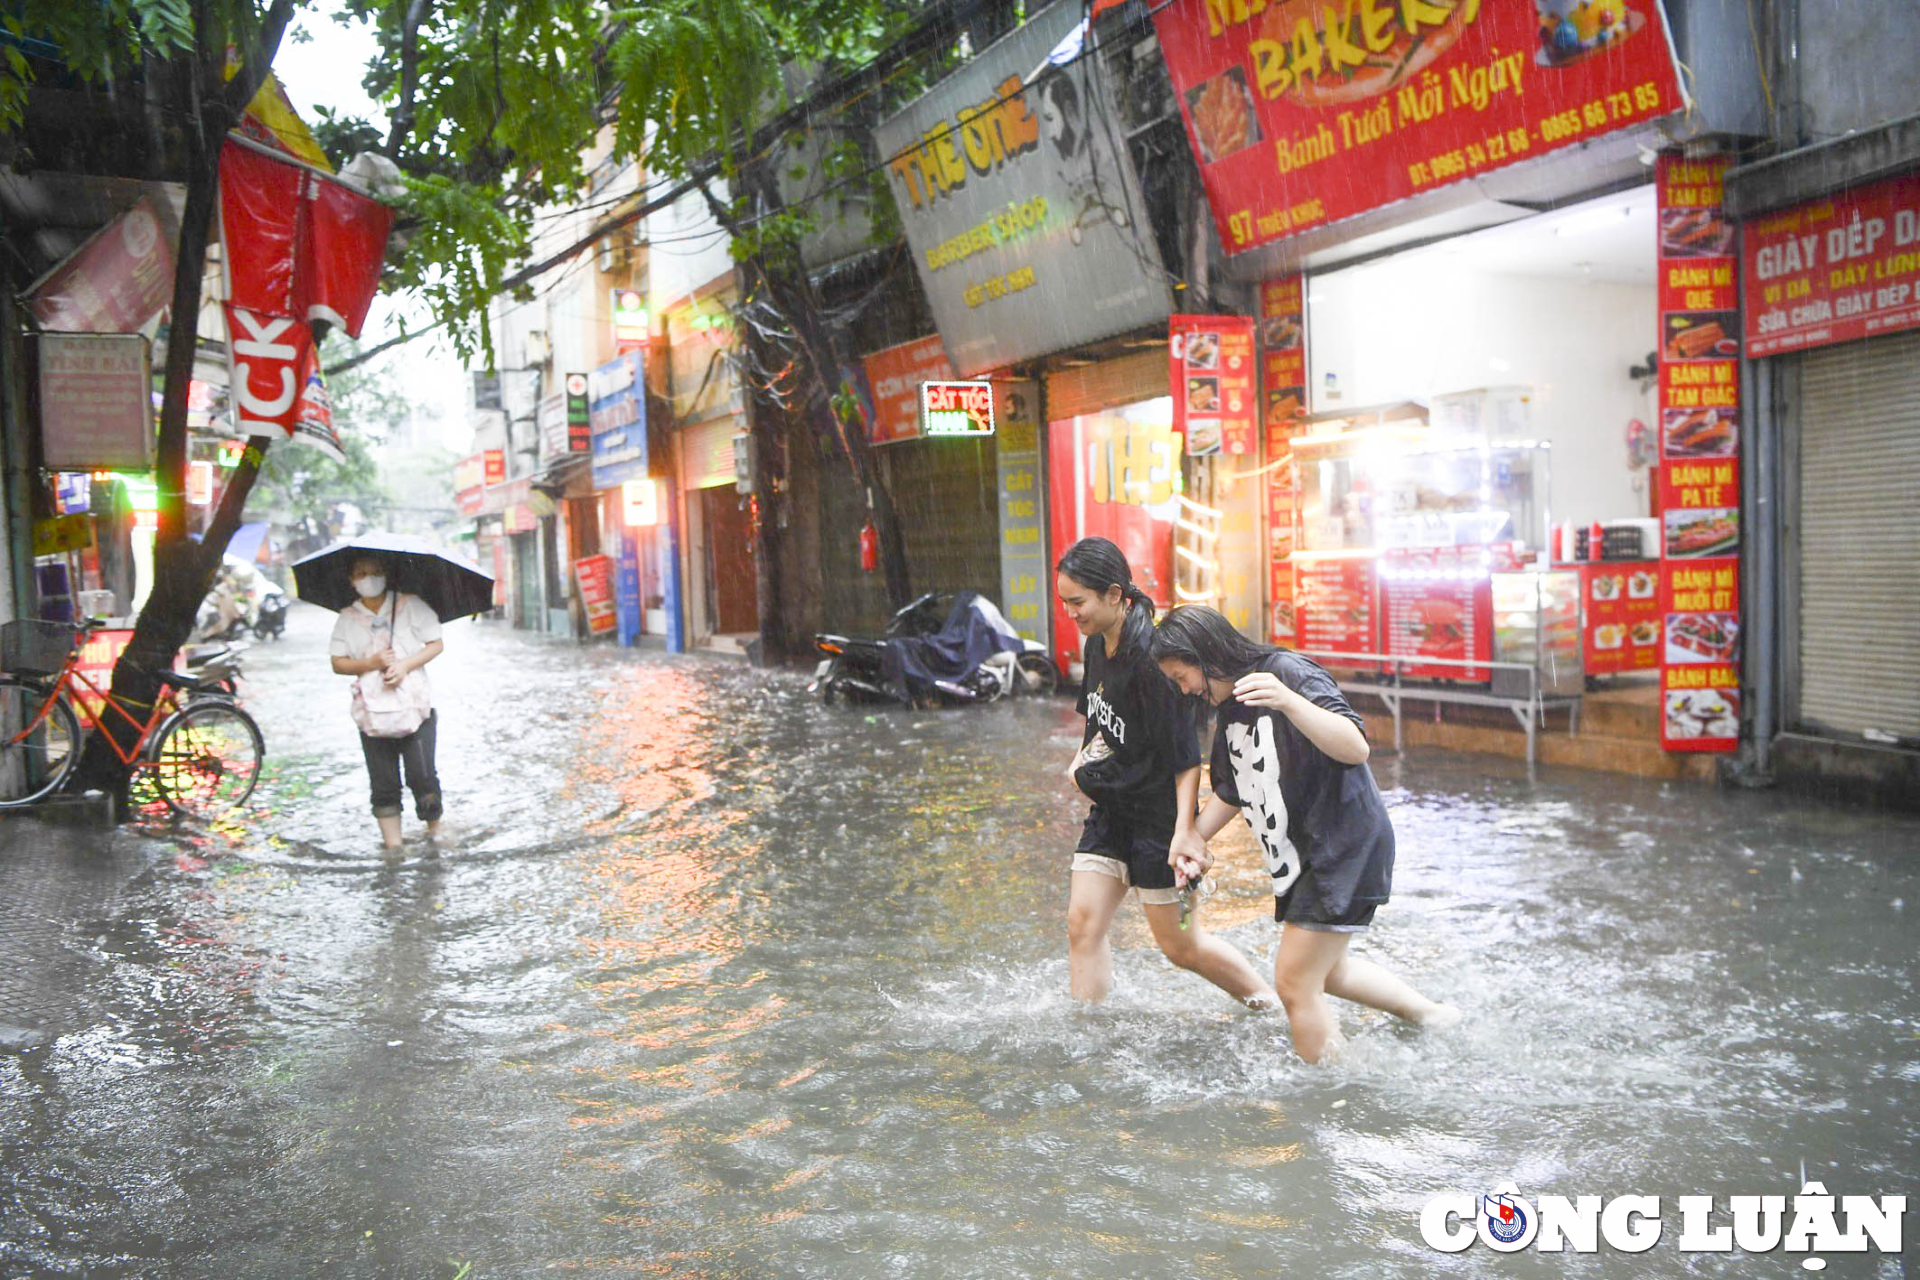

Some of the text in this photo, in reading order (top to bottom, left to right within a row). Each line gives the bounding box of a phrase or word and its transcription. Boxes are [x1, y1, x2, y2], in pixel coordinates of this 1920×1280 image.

[1276, 47, 1526, 174] Bánh Tươi Mỗi Ngày
[1607, 90, 1634, 119] 73
[1634, 81, 1660, 111] 85
[889, 74, 1039, 212] THE ONE
[1666, 187, 1697, 206] TAM
[926, 196, 1048, 273] BARBER SHOP
[1229, 208, 1254, 245] 97
[1756, 234, 1819, 281] GIÀY
[1827, 207, 1886, 265] DÉP
[1894, 209, 1920, 247] D
[1669, 264, 1710, 288] BÁNH
[1874, 250, 1920, 280] LƯN
[1835, 289, 1873, 317] GIÀY
[1876, 282, 1911, 309] DÉP
[1669, 363, 1710, 385] BÁNH
[928, 386, 958, 411] CẮT
[959, 386, 989, 411] TÓC
[1667, 384, 1736, 406] TAM GIÁC
[930, 411, 968, 431] NAM
[1671, 464, 1711, 487] BÁNH
[1681, 488, 1701, 508] PA
[1672, 566, 1712, 590] BÁNH
[1666, 665, 1738, 689] BÁNH BAO
